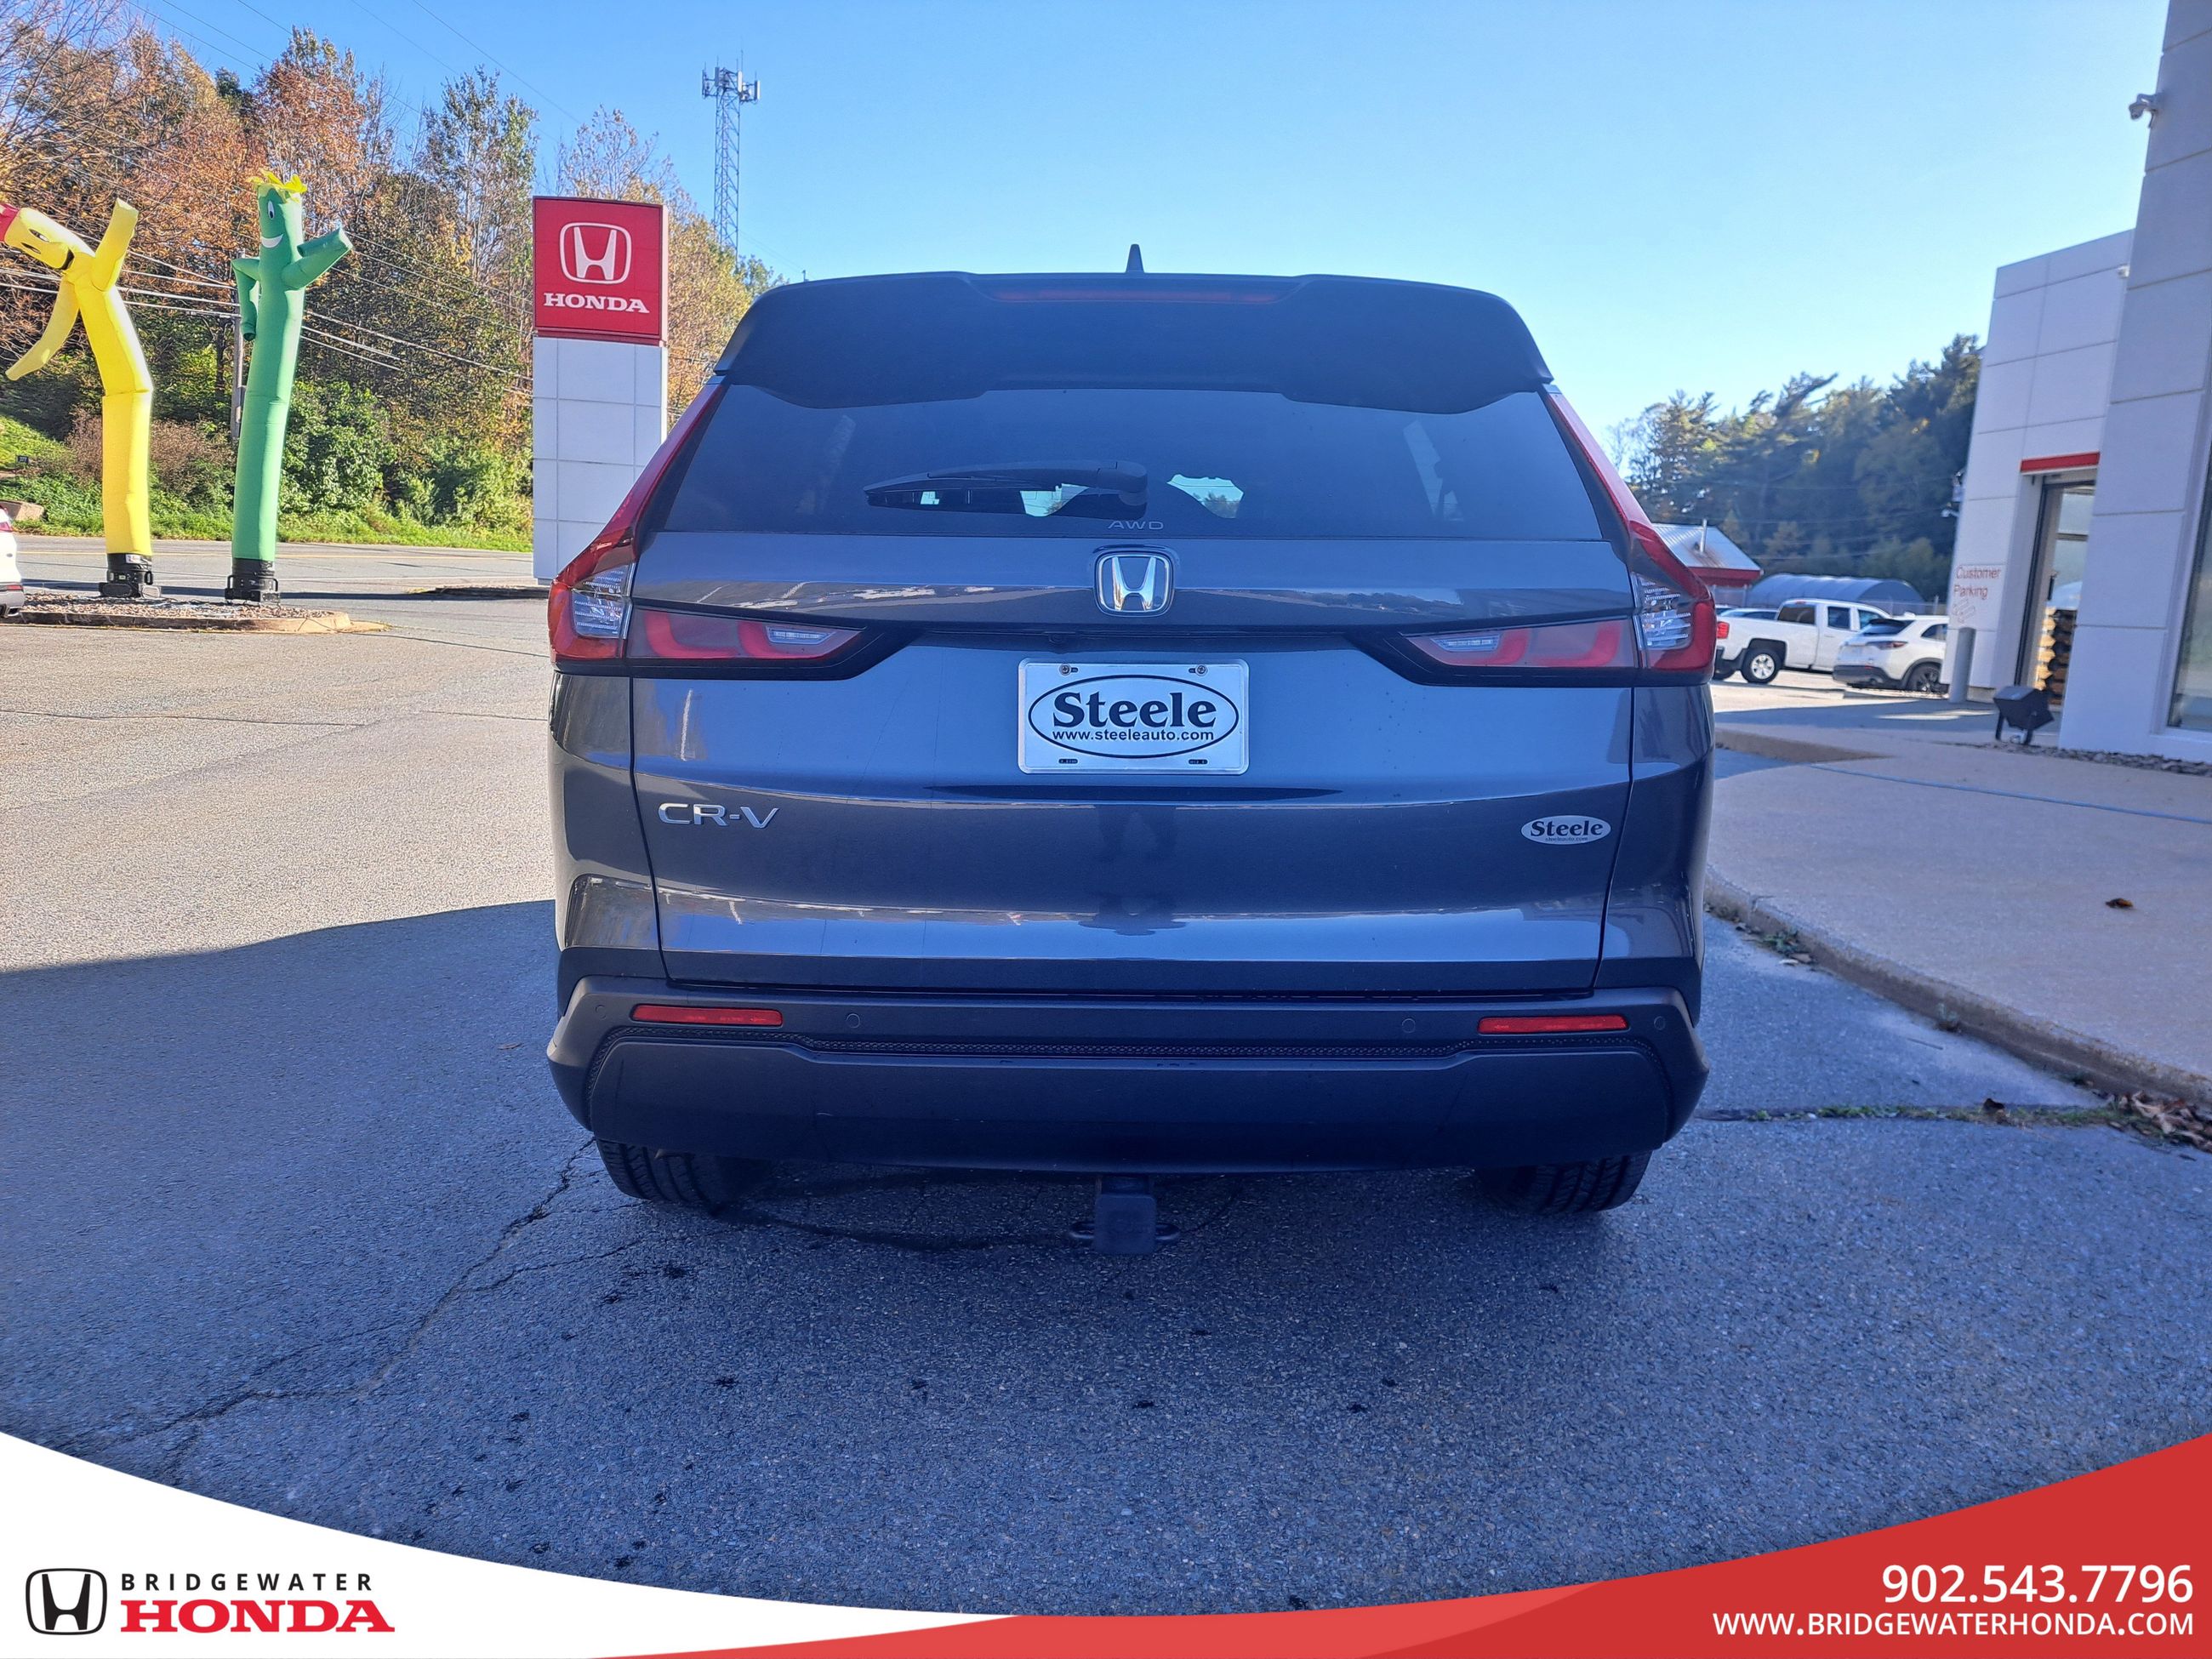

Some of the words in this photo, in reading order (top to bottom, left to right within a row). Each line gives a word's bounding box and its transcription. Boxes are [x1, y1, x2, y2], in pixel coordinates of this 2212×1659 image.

[543, 292, 651, 314] HONDA
[1108, 521, 1165, 530] AWD
[1956, 565, 2001, 579] Customer
[1954, 584, 1988, 601] Parking
[1052, 691, 1217, 729] Steele
[1052, 728, 1215, 741] www.steeleauto.com
[658, 802, 780, 829] CR-V
[1530, 820, 1604, 836] Steele
